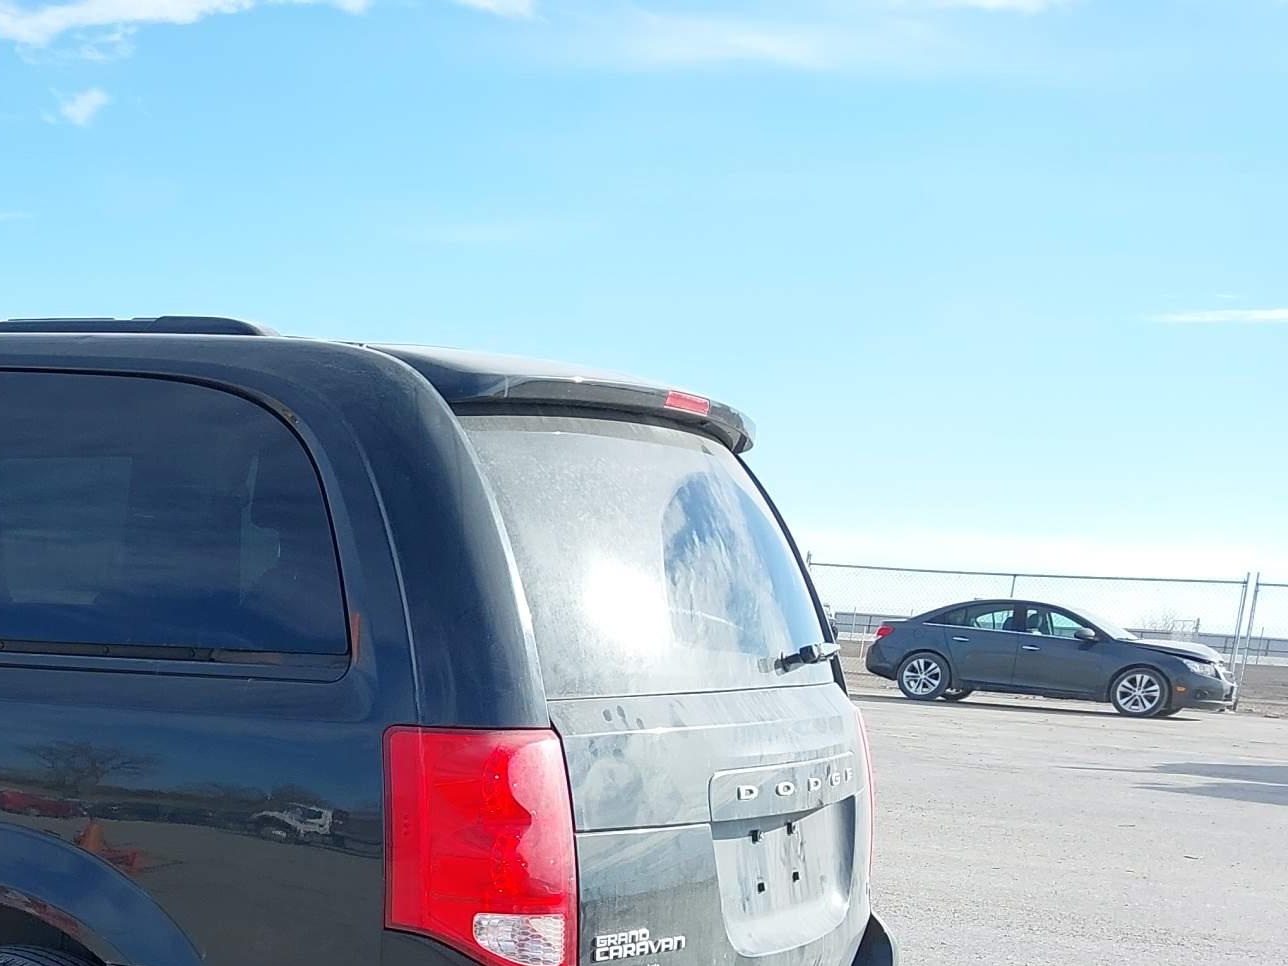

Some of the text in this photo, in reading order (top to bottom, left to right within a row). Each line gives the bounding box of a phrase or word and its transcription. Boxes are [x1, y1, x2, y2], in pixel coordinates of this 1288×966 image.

[737, 767, 854, 800] DODGE
[594, 928, 650, 948] GRAND
[594, 935, 686, 962] CARAVAN
